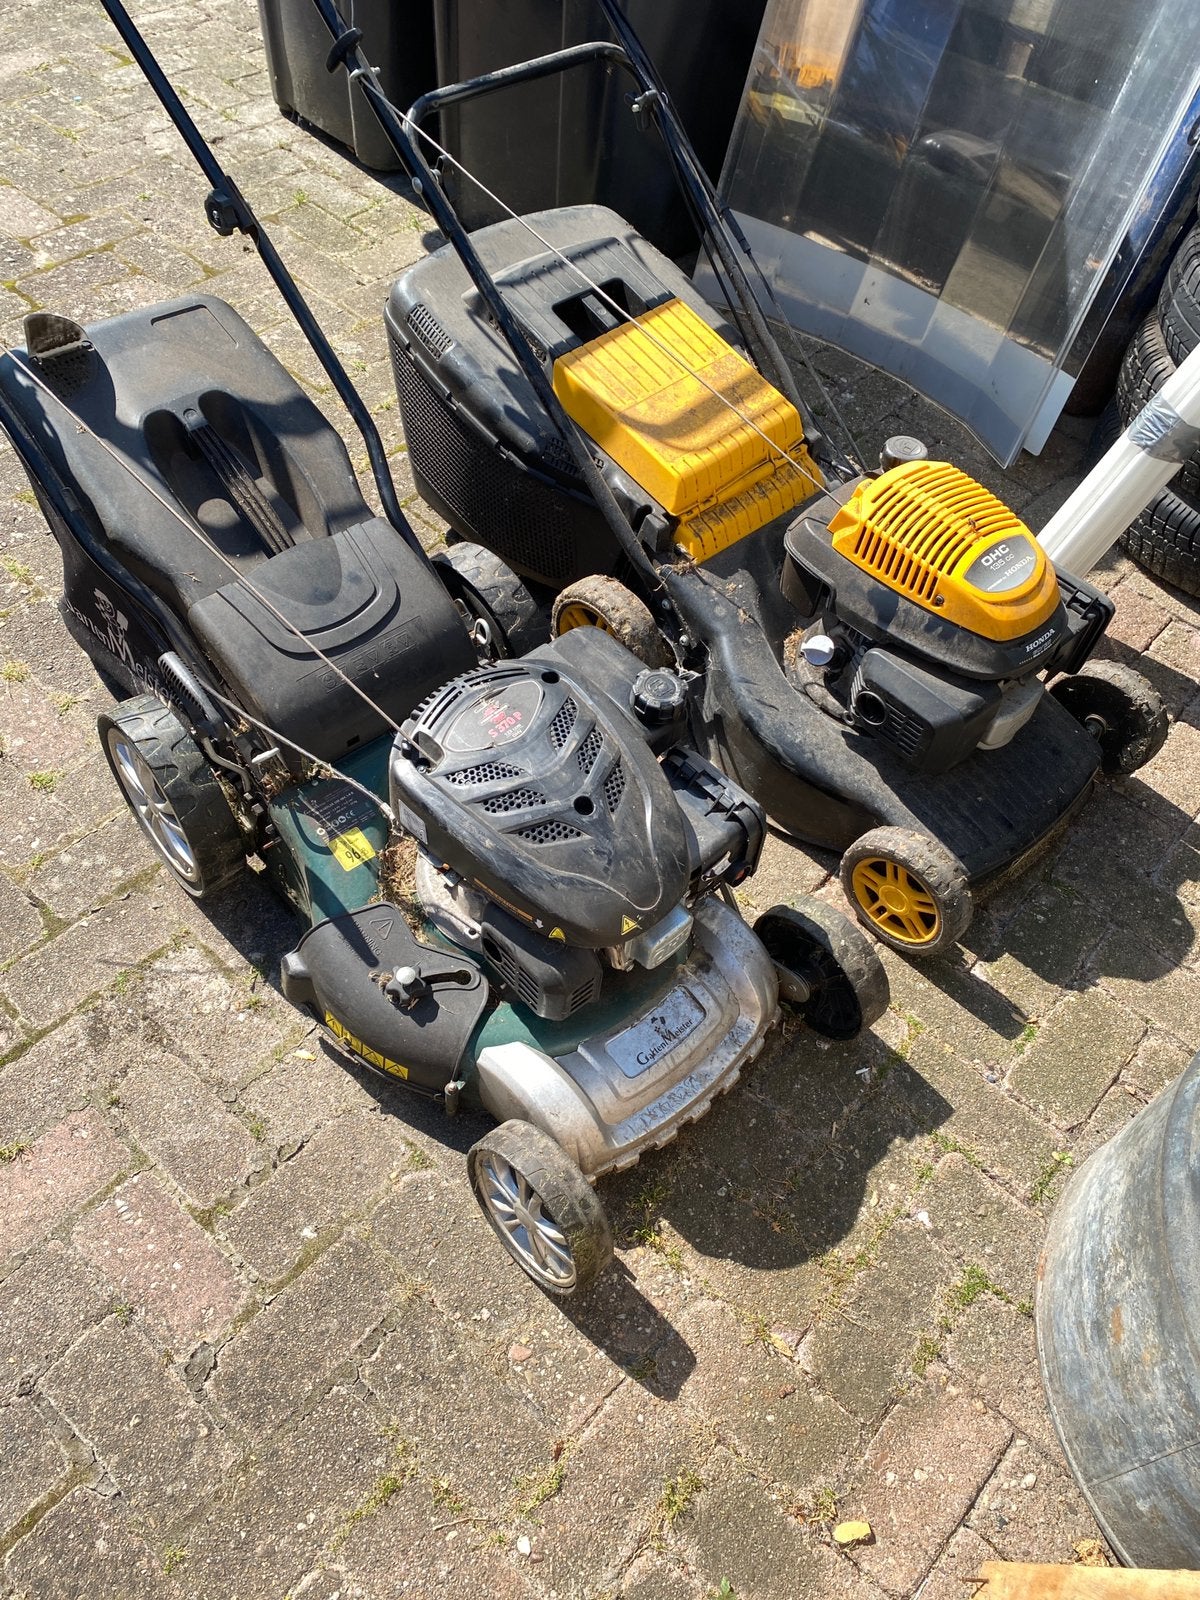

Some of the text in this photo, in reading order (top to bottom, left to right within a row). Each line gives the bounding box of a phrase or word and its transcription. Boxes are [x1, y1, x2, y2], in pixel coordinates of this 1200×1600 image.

[981, 544, 1010, 567] OHC
[990, 558, 1006, 571] 135
[1004, 555, 1035, 577] HONDA
[1025, 628, 1056, 653] HONDA
[488, 728, 499, 738] S
[345, 848, 361, 863] 96
